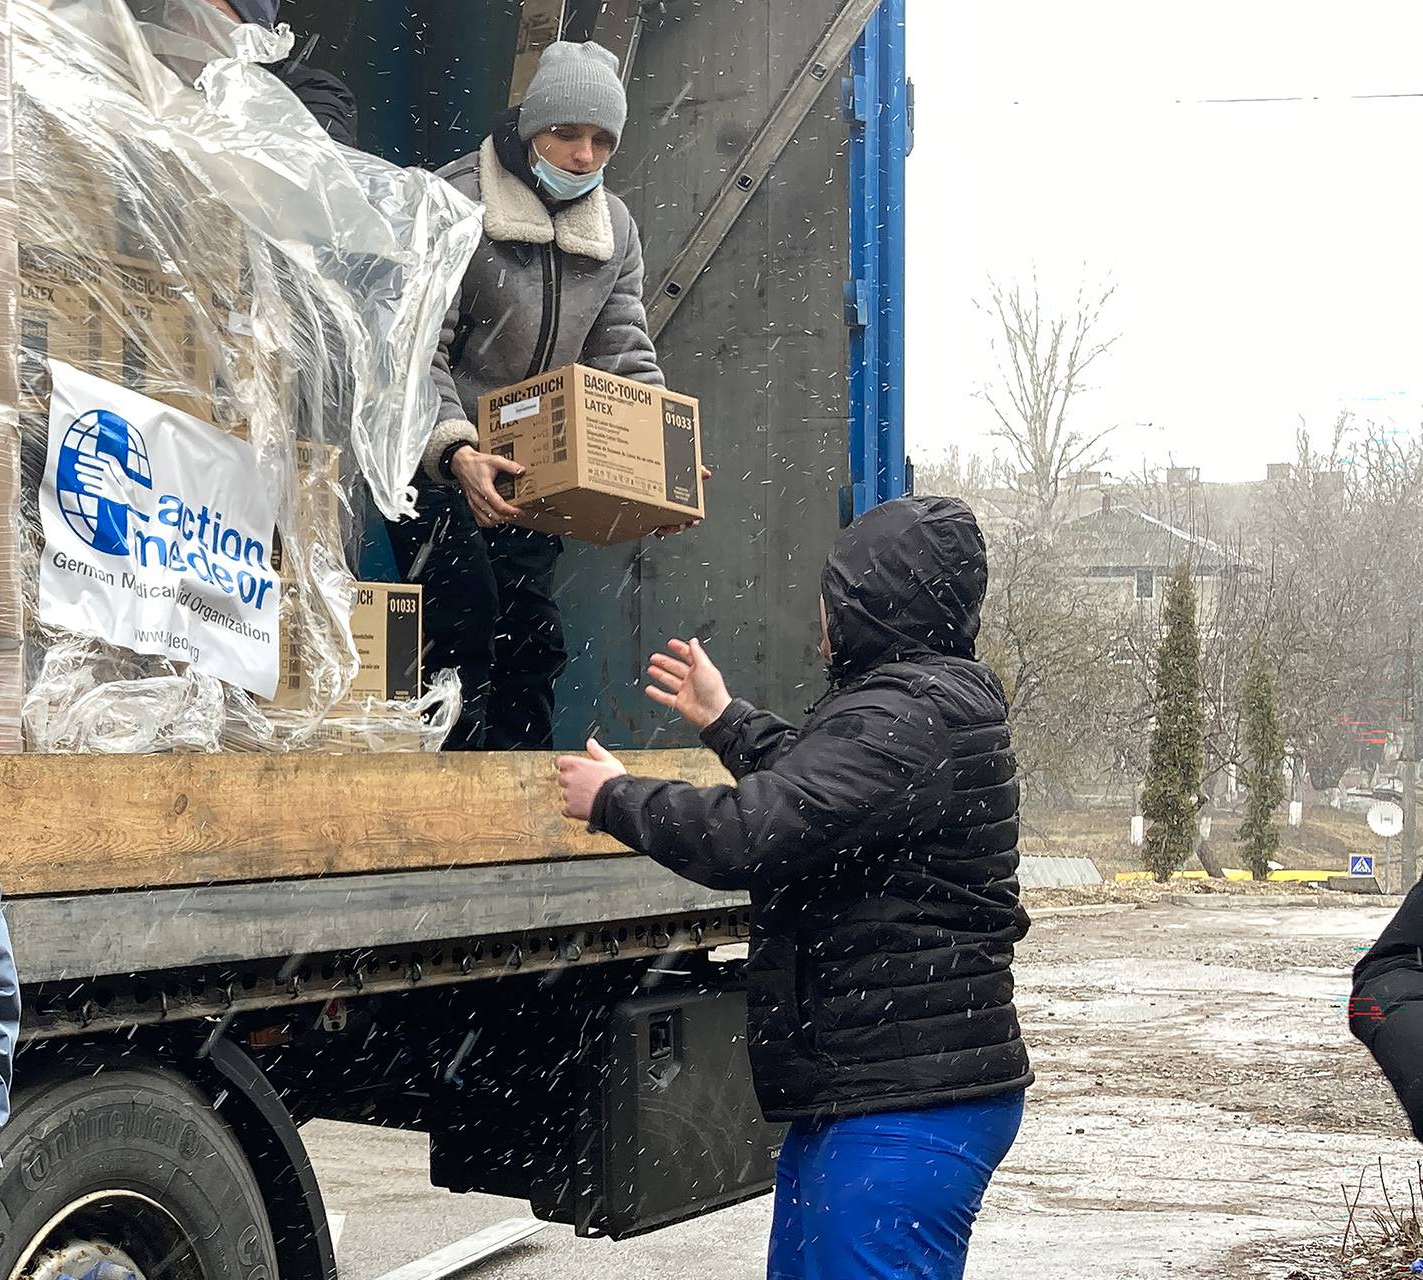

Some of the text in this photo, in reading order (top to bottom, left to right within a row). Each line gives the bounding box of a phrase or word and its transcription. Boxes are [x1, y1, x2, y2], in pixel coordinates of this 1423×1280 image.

[583, 398, 614, 416] LATEX
[665, 412, 692, 430] 01033
[158, 494, 268, 572] action
[133, 527, 274, 610] medeor
[53, 551, 115, 587] German
[190, 597, 271, 644] Organization
[390, 599, 416, 613] 01033
